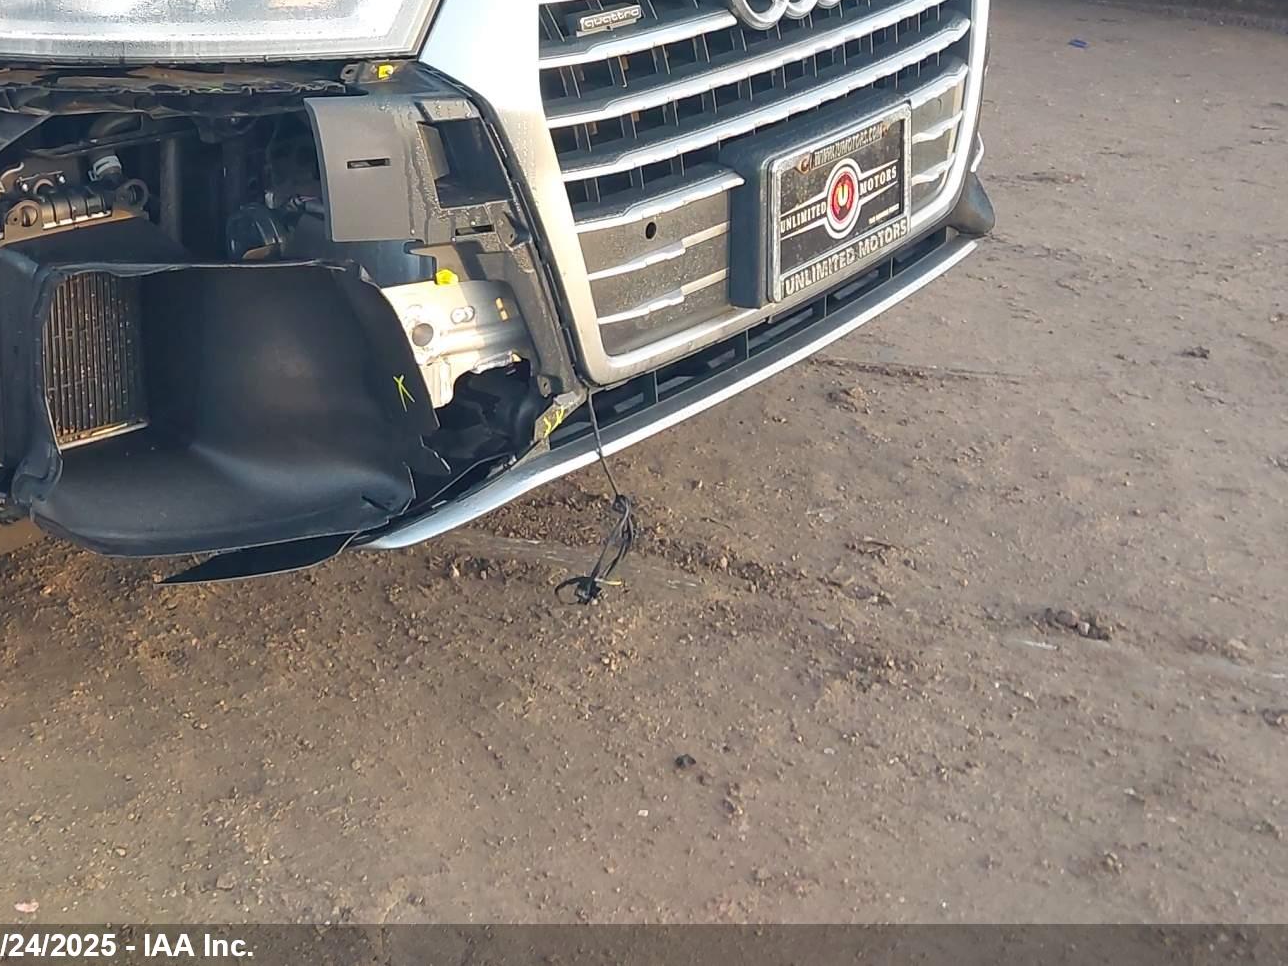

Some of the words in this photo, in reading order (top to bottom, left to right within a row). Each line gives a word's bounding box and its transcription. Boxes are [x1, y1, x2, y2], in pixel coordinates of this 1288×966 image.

[584, 8, 640, 28] quattro
[780, 201, 827, 234] UNLIMITED
[861, 166, 898, 195] MOTORS
[785, 246, 856, 295] UNLIMITED
[858, 222, 908, 260] MOTORS
